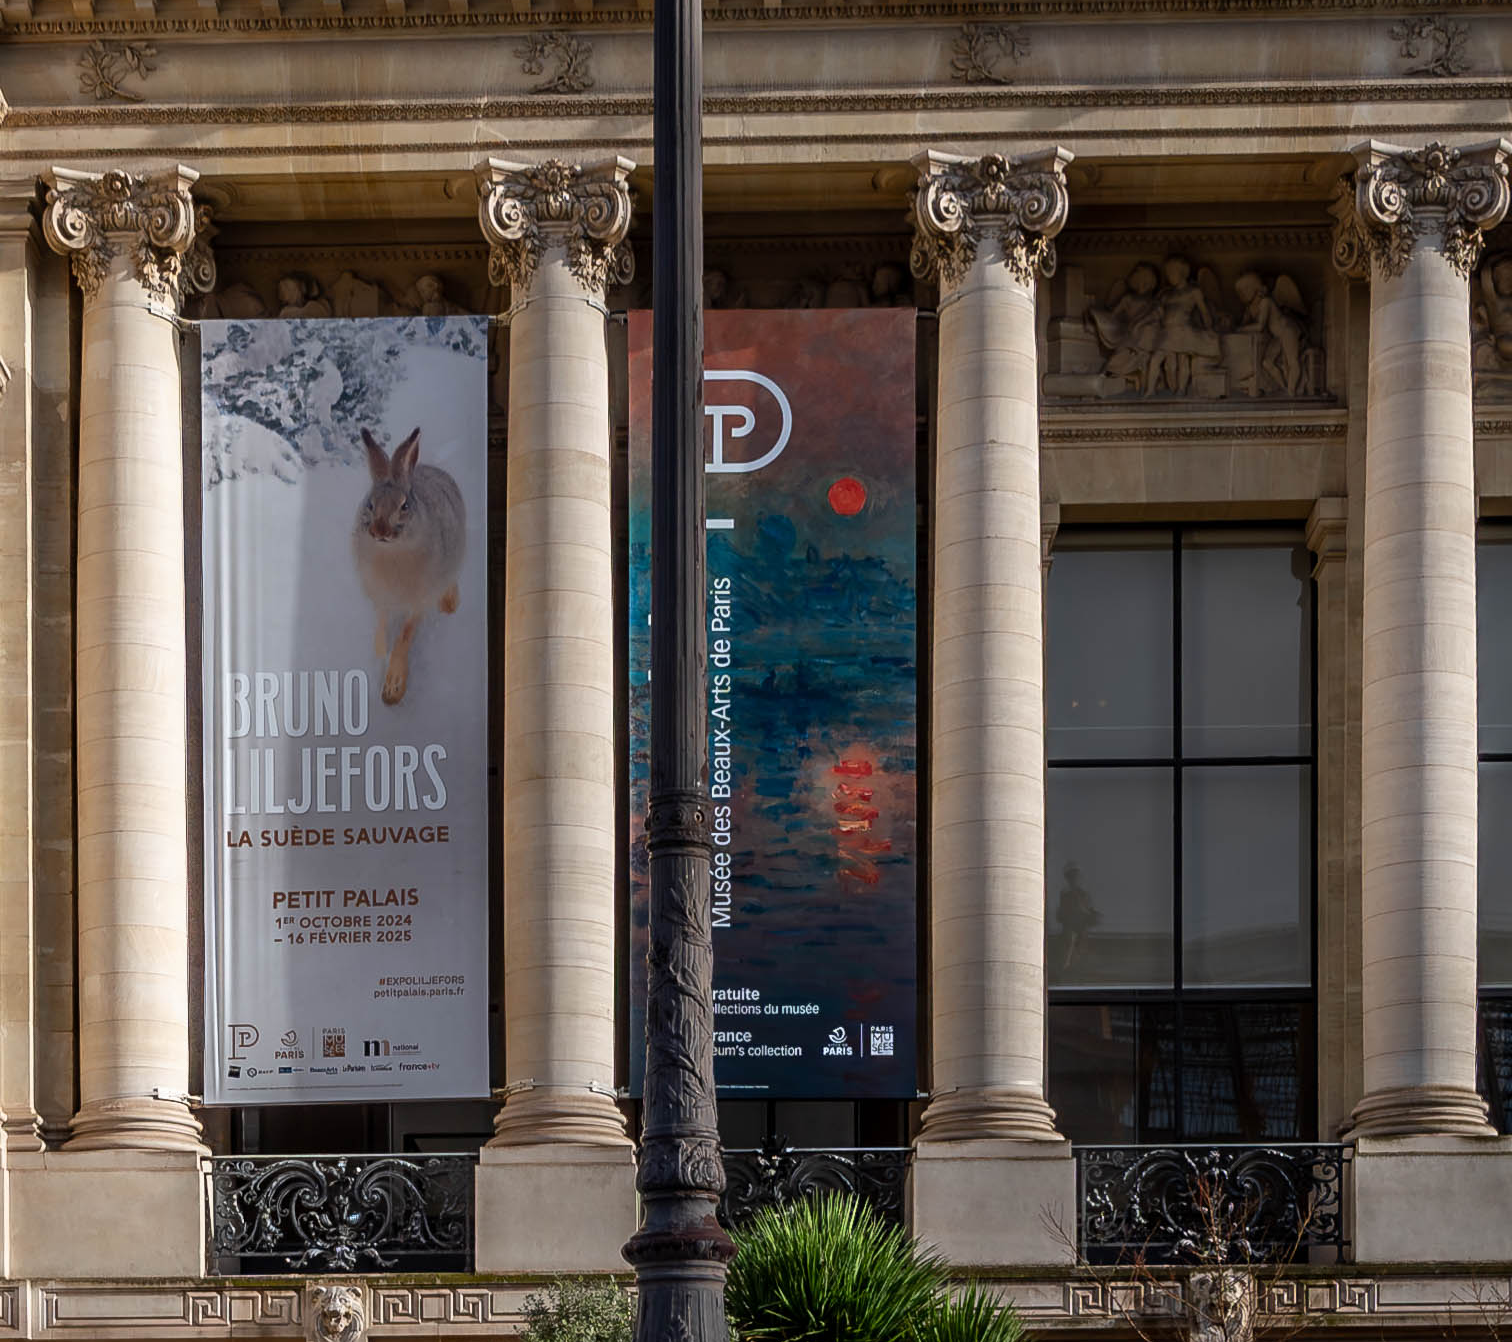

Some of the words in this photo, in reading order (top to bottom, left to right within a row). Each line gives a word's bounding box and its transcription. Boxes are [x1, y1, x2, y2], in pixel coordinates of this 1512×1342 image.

[710, 577, 731, 632] Paris
[710, 639, 731, 668] de
[226, 669, 369, 739] BRUNO
[710, 673, 731, 799] Beaux-Arts
[226, 744, 448, 816] LILJEFORS
[226, 831, 253, 848] LA
[261, 825, 335, 847] SUÈDE
[343, 826, 449, 845] SAUVAGE
[710, 805, 731, 849] des
[272, 890, 335, 909] PETIT
[343, 888, 419, 908] PALAIS
[710, 852, 731, 928] Musée
[299, 915, 371, 928] OCTOBRE
[377, 914, 412, 927] 2024
[288, 932, 304, 944] 16
[309, 929, 371, 944] FÉVRIER
[377, 930, 412, 942] 2025
[712, 987, 760, 1000] ratuite
[713, 1003, 761, 1015] llections
[764, 1003, 779, 1015] du
[781, 1002, 819, 1015] musée
[713, 1030, 752, 1042] rance
[274, 1050, 305, 1060] PARIS
[712, 1045, 745, 1056] eum's
[748, 1044, 803, 1056] collection
[823, 1046, 853, 1056] PARIS
